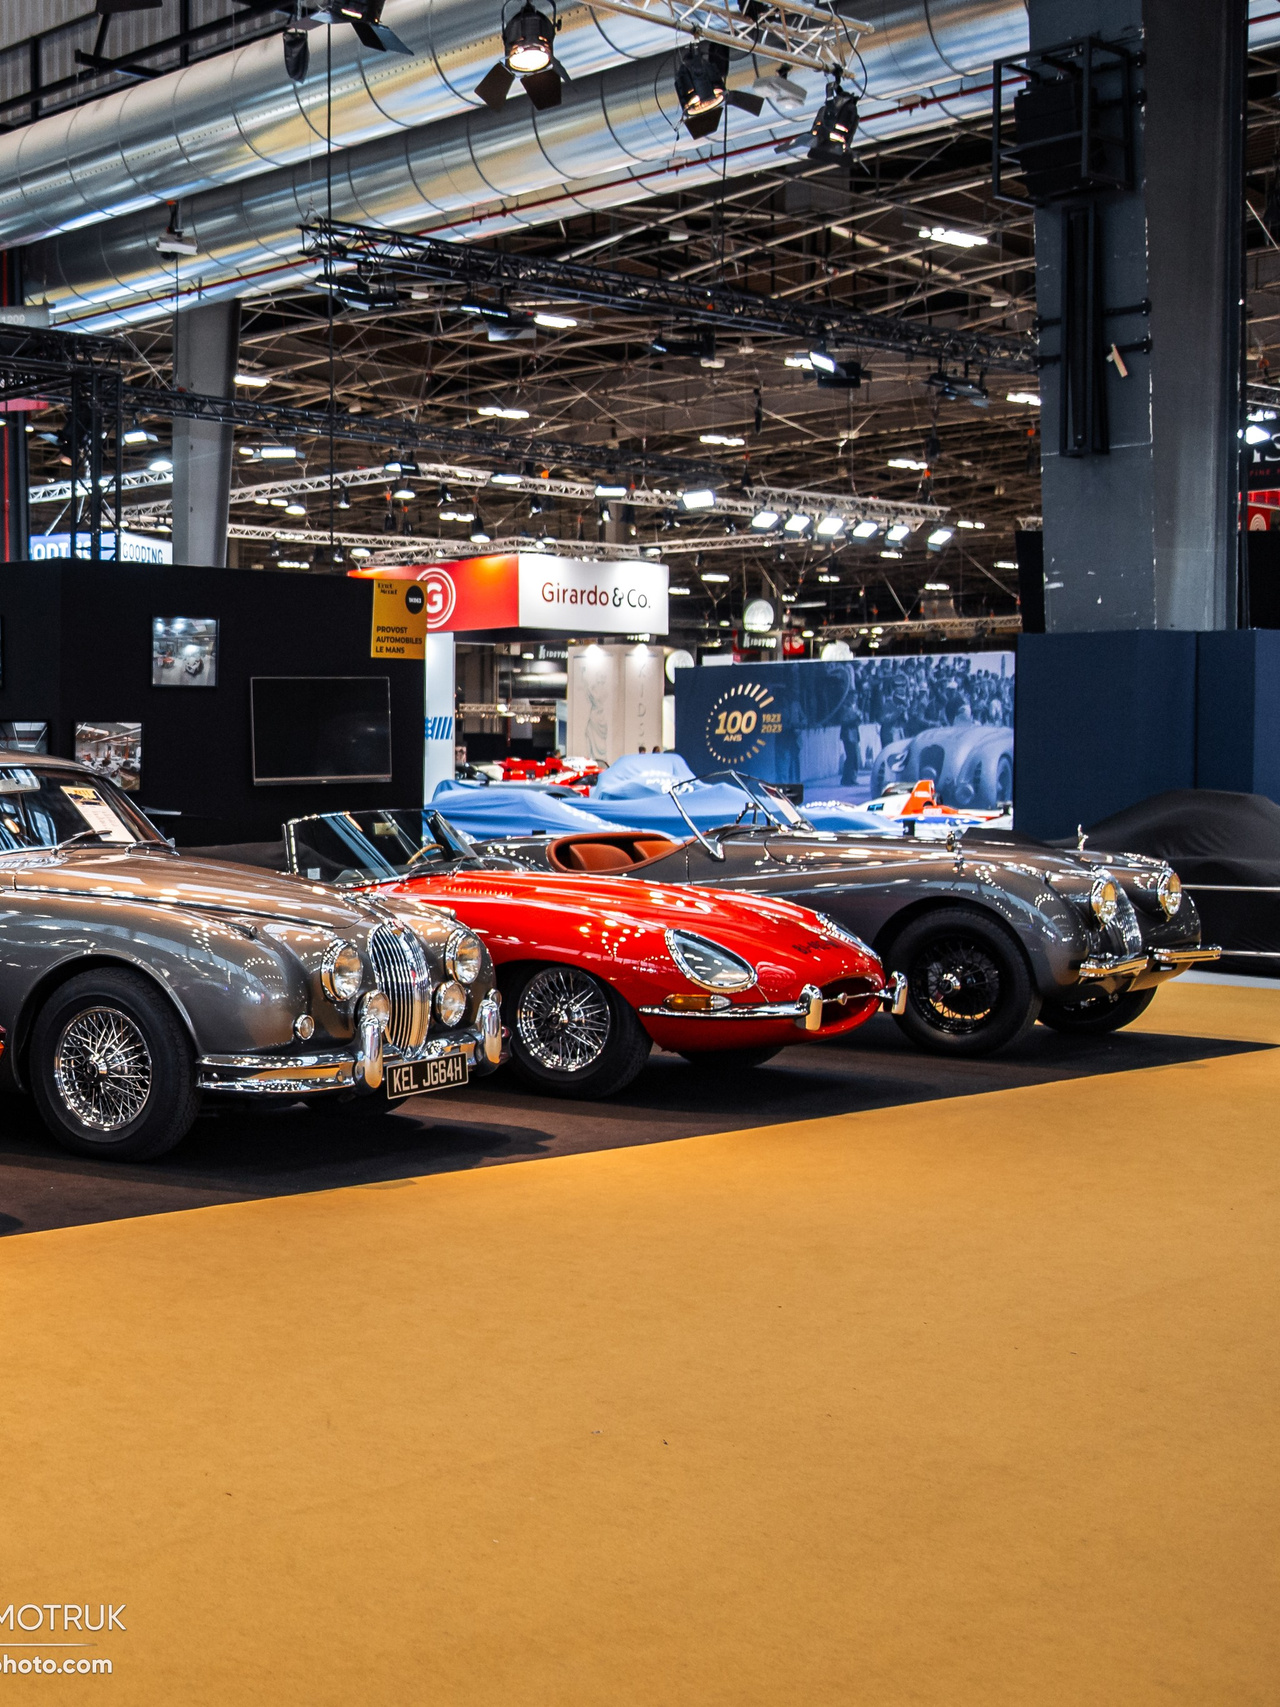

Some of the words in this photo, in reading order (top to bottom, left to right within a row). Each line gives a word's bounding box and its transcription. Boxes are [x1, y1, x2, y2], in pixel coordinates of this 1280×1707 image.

[122, 542, 164, 564] GOODING
[427, 582, 443, 614] G
[541, 582, 609, 606] Girardo
[612, 587, 624, 607] &
[627, 588, 651, 609] Co.
[375, 636, 423, 645] AUTOMOBILES
[376, 625, 408, 634] PROVOST
[385, 646, 405, 654] MANS
[714, 710, 758, 735] 100
[723, 734, 743, 742] ANS
[393, 1065, 419, 1093] KEL
[422, 1056, 463, 1087] JG64H
